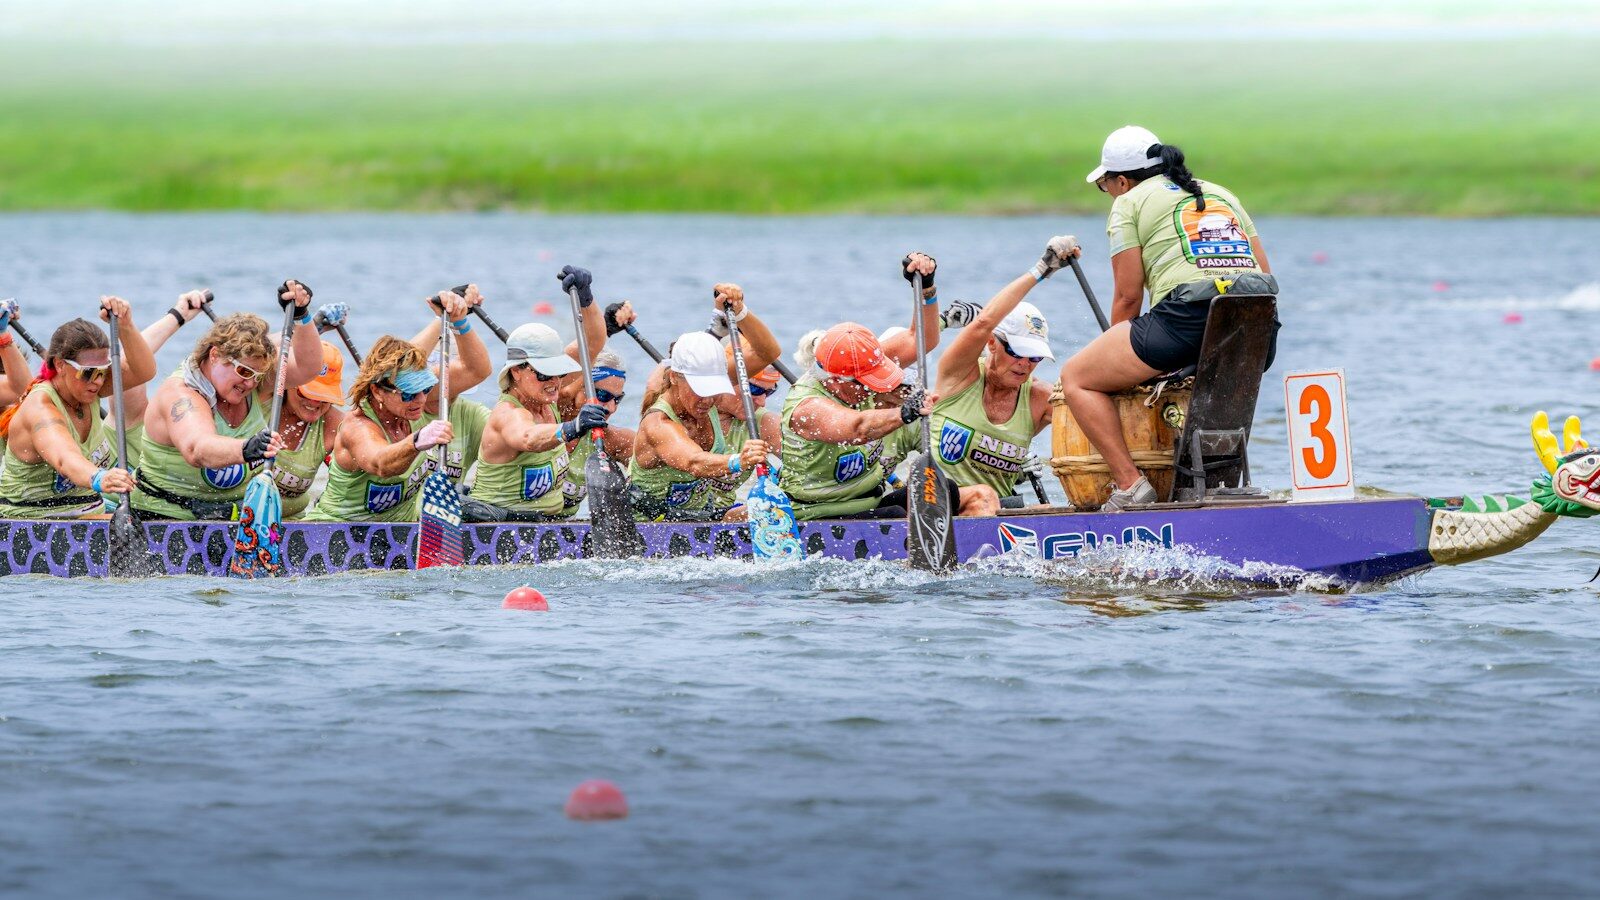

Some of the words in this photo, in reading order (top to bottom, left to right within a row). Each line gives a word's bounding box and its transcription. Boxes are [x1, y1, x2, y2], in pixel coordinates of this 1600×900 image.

[1199, 258, 1254, 268] PADDLING
[735, 352, 751, 396] HORNET
[1299, 384, 1337, 480] 3
[419, 502, 461, 527] USA
